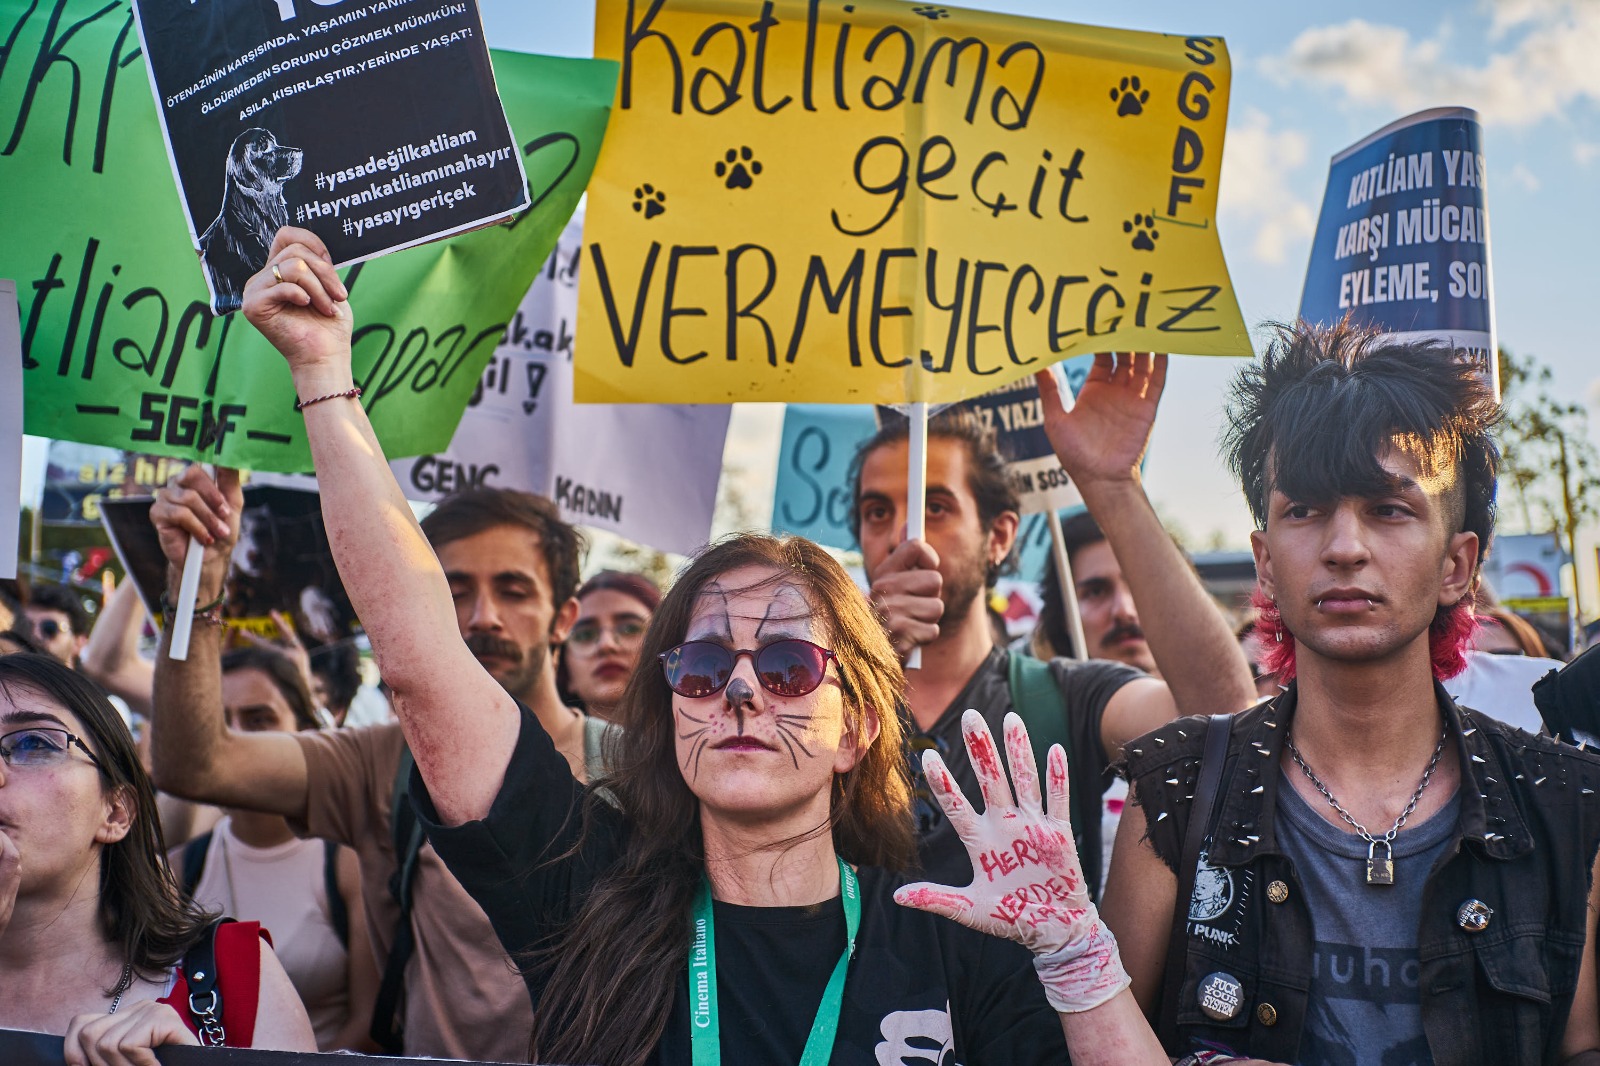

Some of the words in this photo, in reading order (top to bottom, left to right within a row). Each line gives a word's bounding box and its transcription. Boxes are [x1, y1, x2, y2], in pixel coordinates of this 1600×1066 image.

[167, 68, 227, 108] ÖTENAZİNİN
[226, 32, 300, 74] KARŞISINDA,
[301, 9, 366, 38] YAŞAMIN
[201, 68, 271, 114] ÖLDÜRMEDEN
[271, 48, 330, 75] SORUNU
[331, 27, 393, 55] ÇÖZMEK
[393, 3, 467, 33] MÜMKÜN!
[239, 96, 273, 120] AŞILA,
[420, 27, 473, 50] YAŞAT!
[619, 0, 1046, 131] Katliama
[296, 146, 511, 223] #Hayvankatliamınahayır
[315, 129, 477, 191] #yasadeğilkatliam
[832, 135, 1089, 237] geçit
[1347, 153, 1433, 209] KATLİAM
[342, 181, 477, 237] #yasayıgeriçek
[1334, 212, 1390, 262] KARŞI
[1339, 262, 1439, 310] EYLEME,
[17, 237, 235, 396] tliam
[692, 918, 708, 967] Italiano
[1194, 923, 1235, 945] PUNK
[693, 971, 711, 1029] Cinema
[1202, 994, 1236, 1017] SYSTEM
[1204, 984, 1239, 1006] YOUR
[1212, 976, 1239, 996] FUCK
